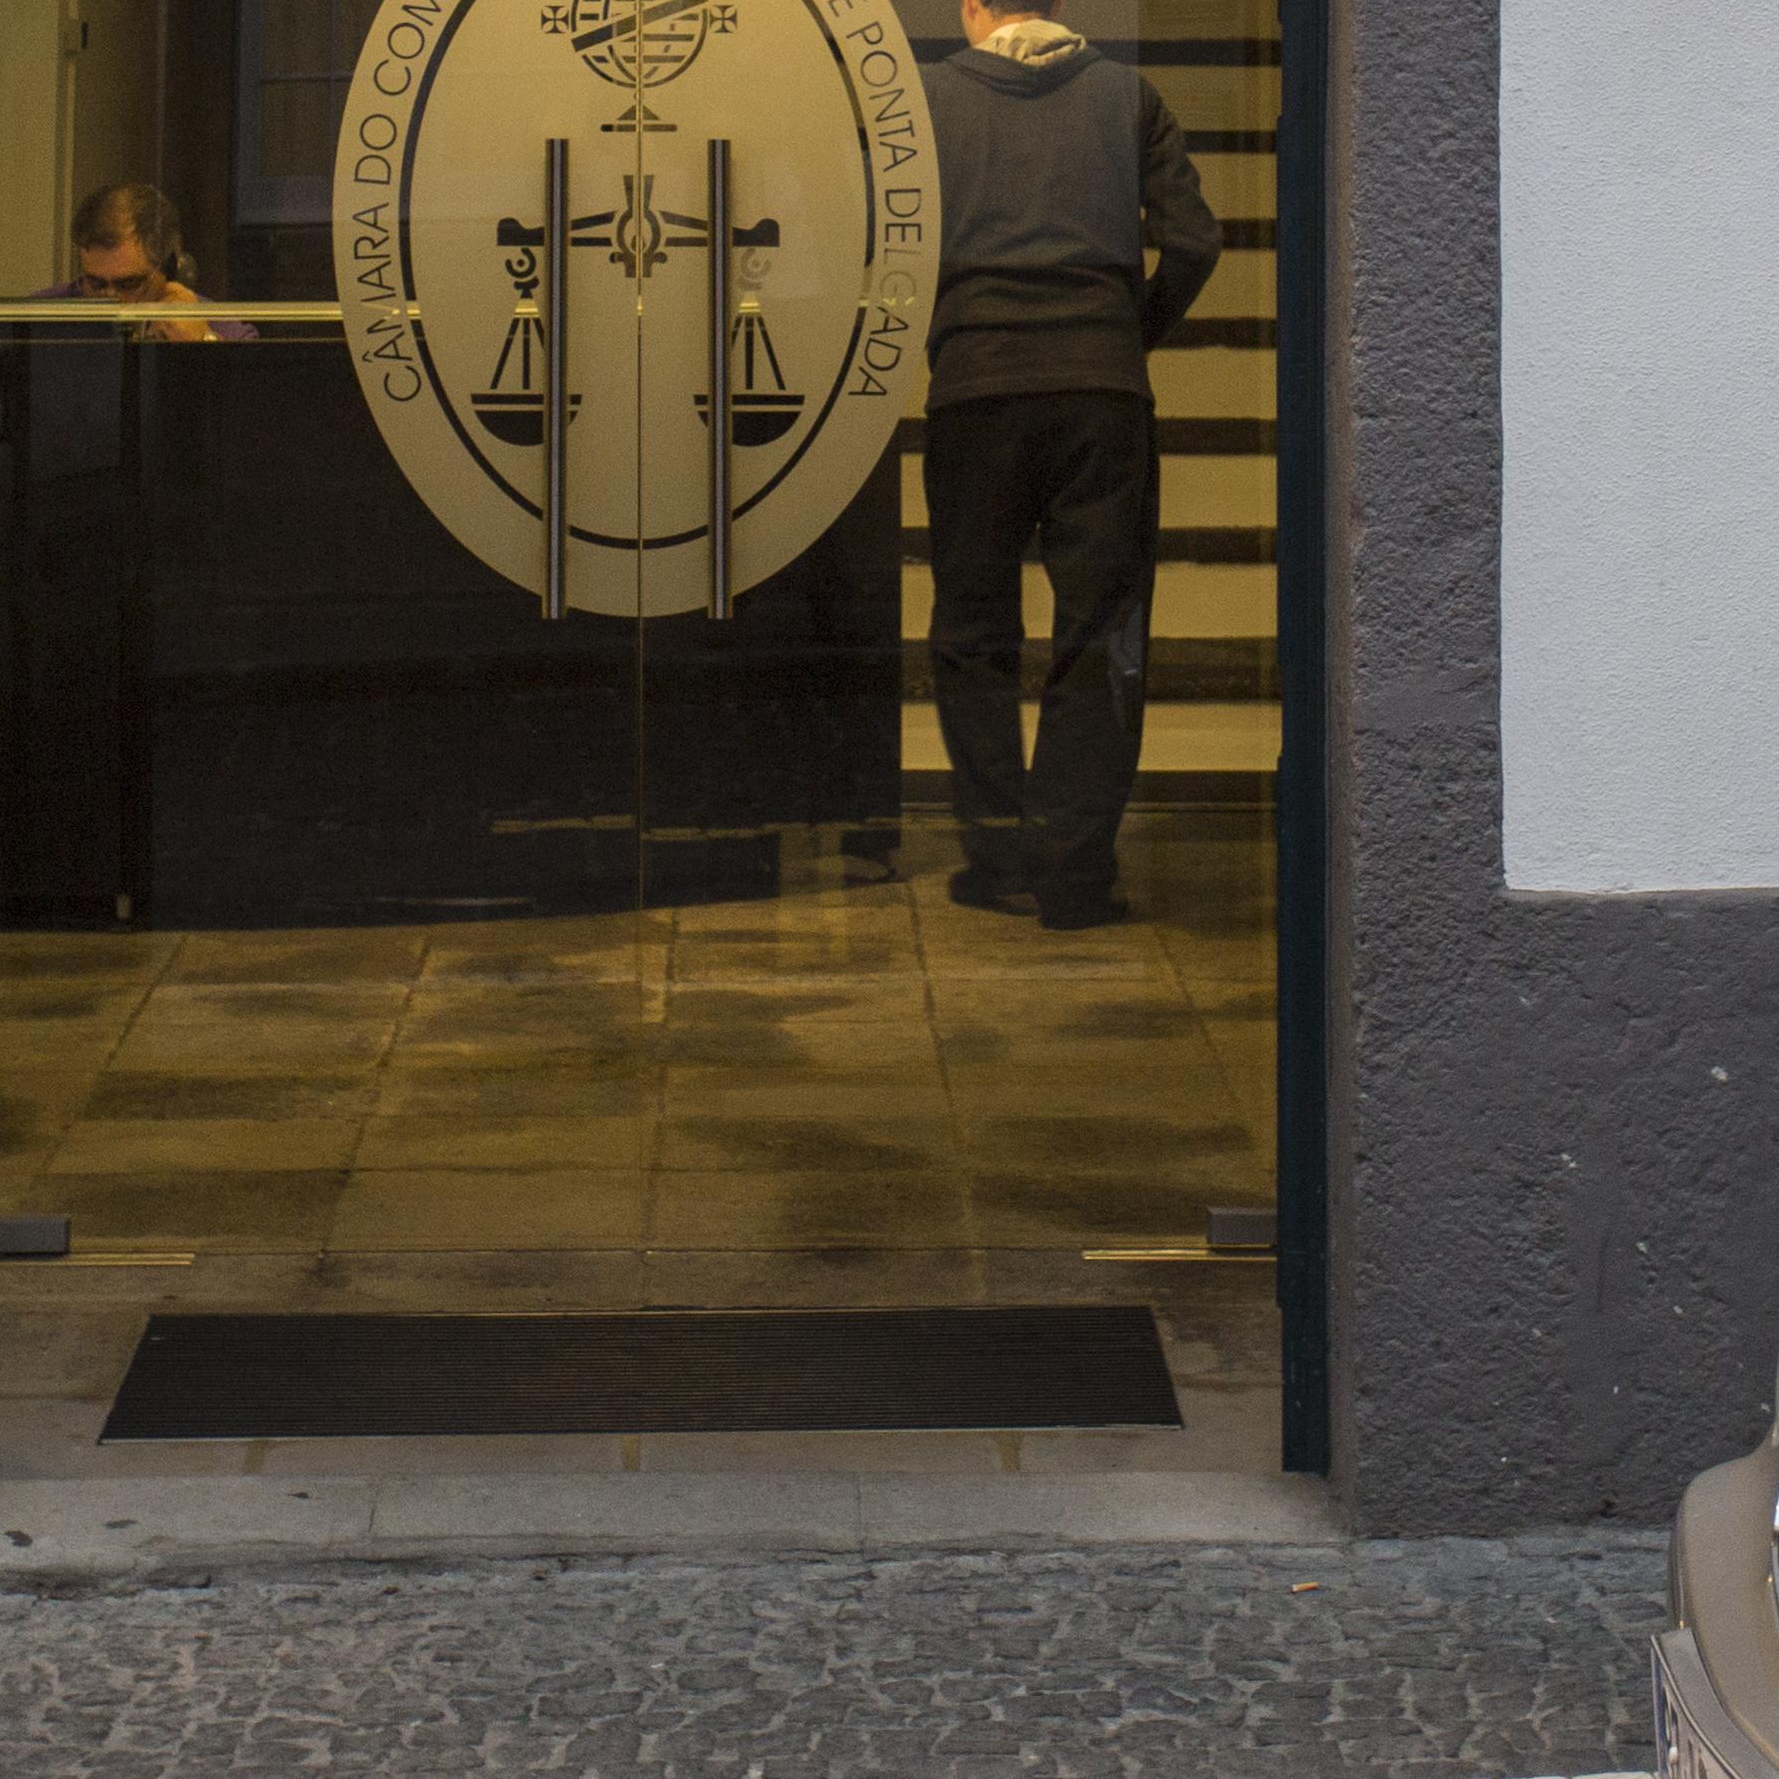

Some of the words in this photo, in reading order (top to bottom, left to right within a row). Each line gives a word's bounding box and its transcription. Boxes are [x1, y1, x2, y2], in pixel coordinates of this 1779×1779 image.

[354, 114, 397, 186] DO
[846, 21, 917, 172] PONTA
[848, 188, 922, 397] DELGADA
